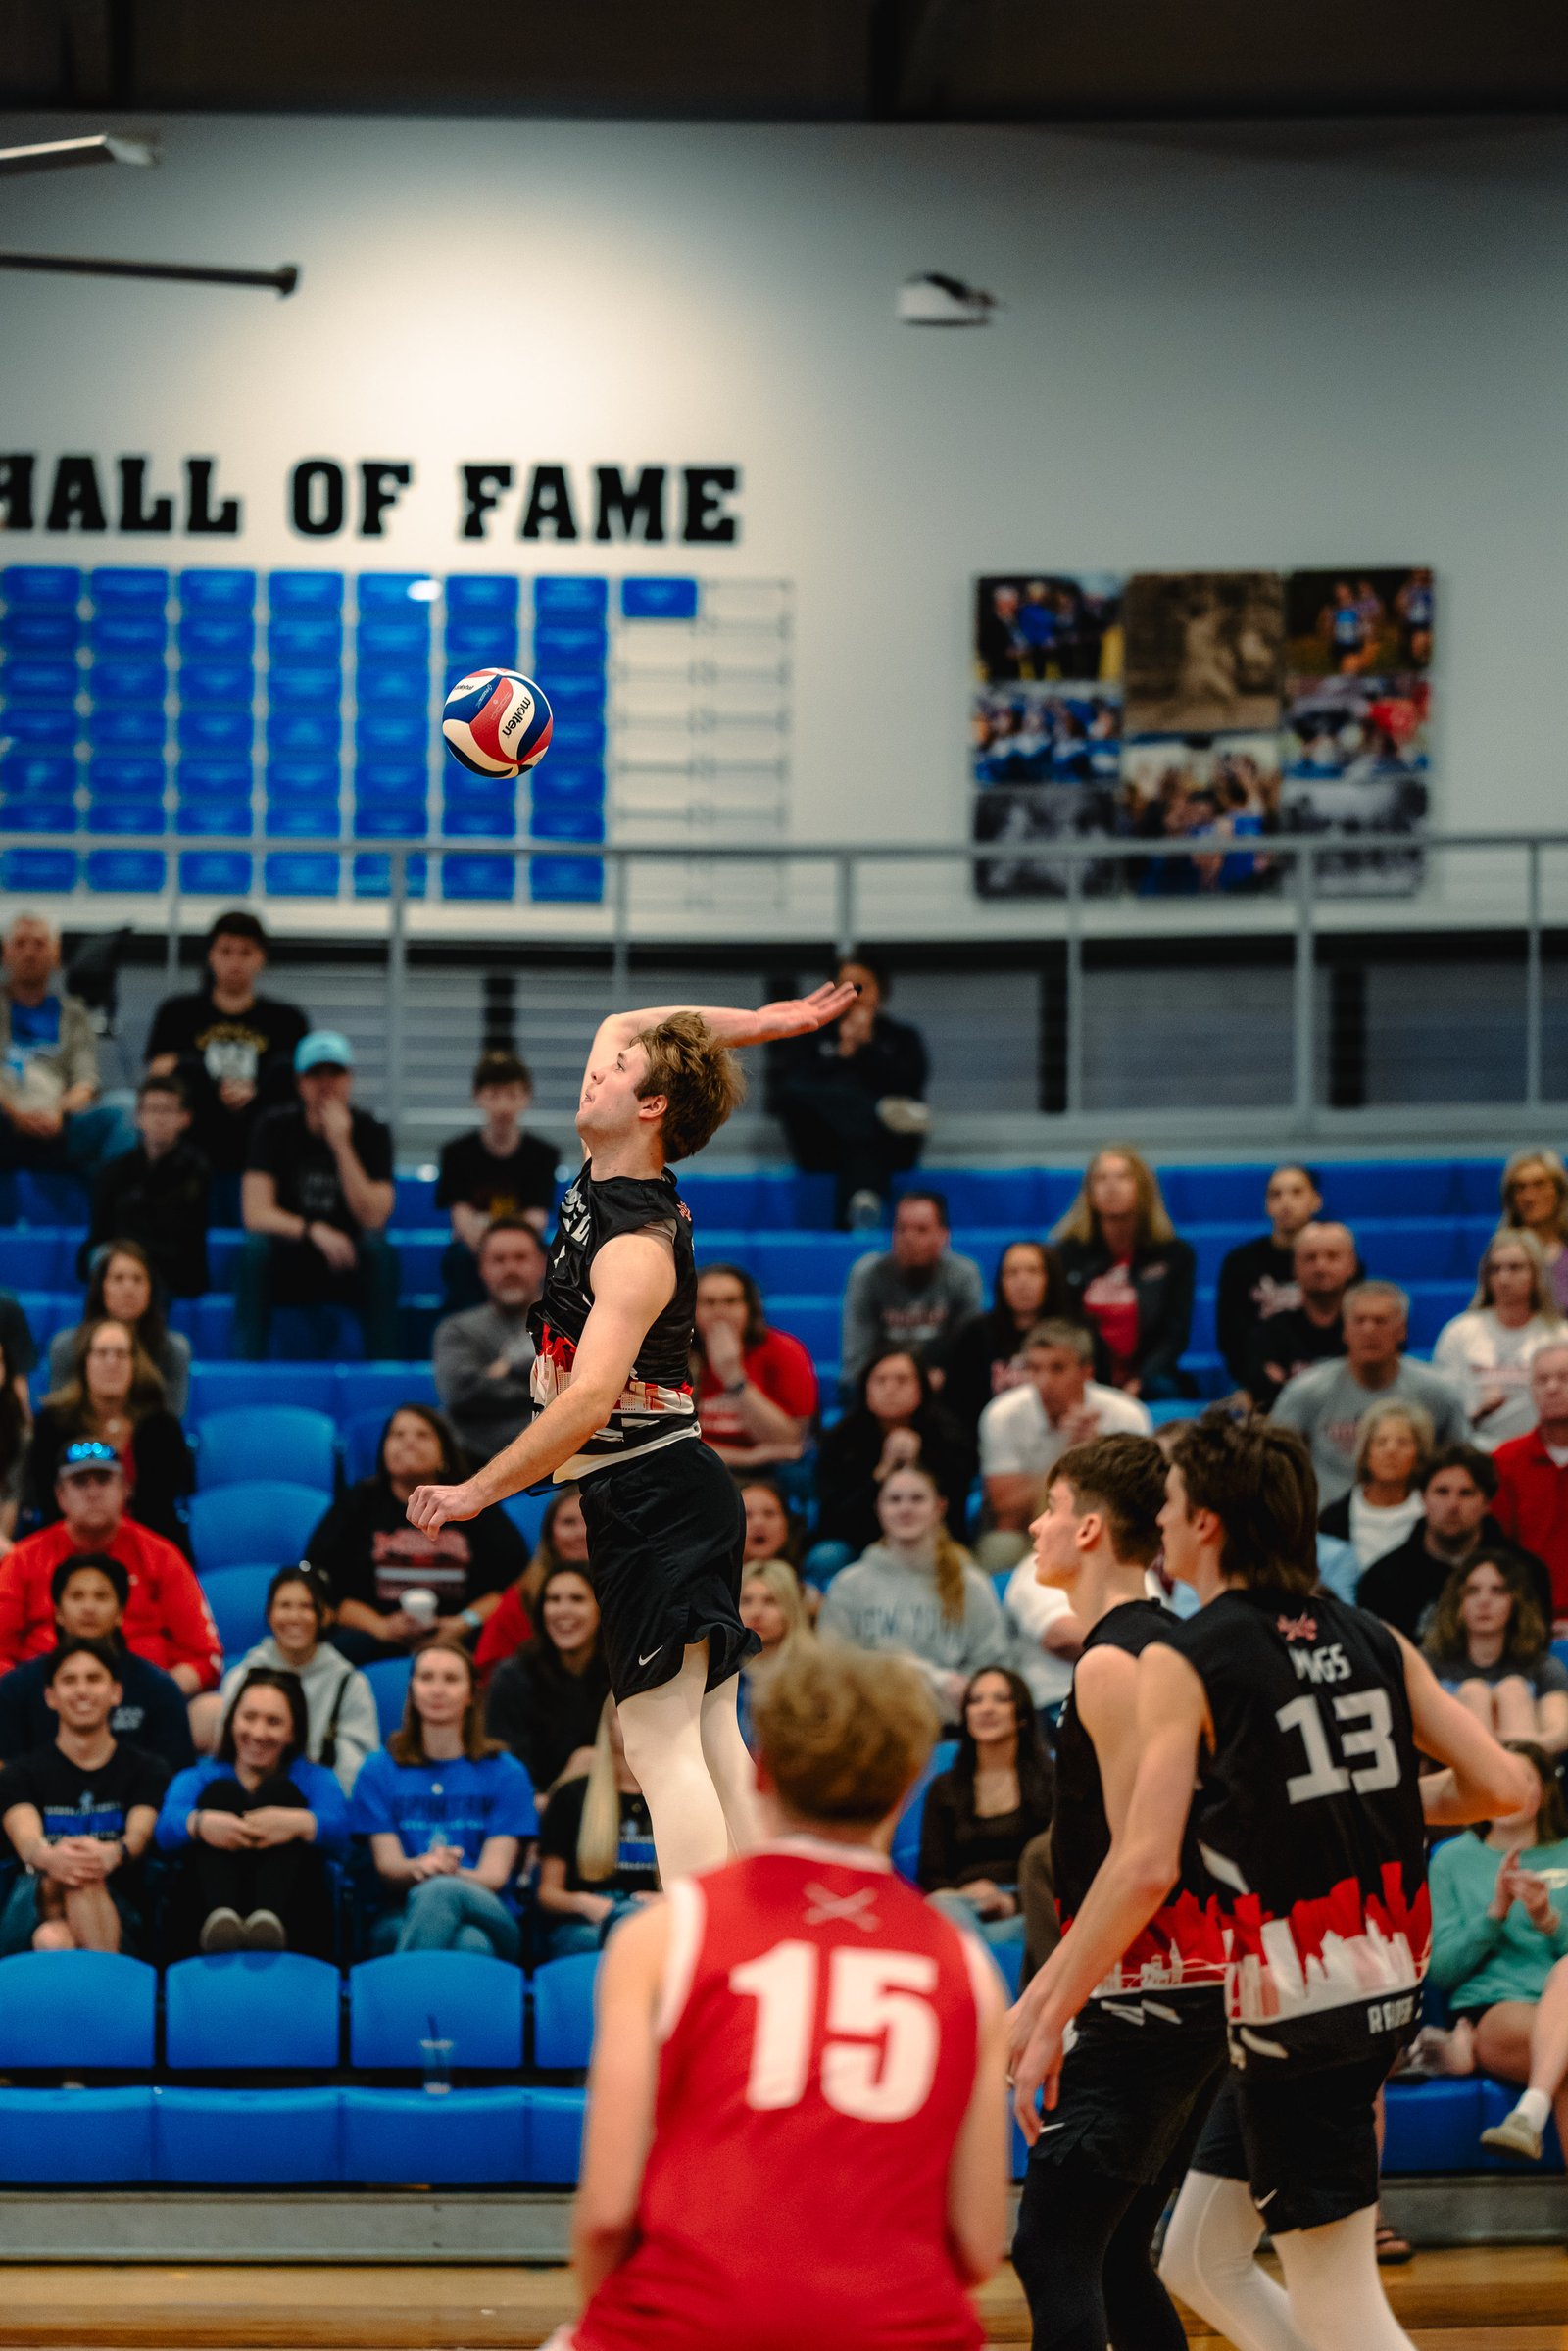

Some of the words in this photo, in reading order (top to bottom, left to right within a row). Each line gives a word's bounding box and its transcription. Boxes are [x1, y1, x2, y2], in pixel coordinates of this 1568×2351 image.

[292, 459, 412, 537] OF
[463, 464, 739, 542] FAME
[502, 696, 531, 737] molten
[1275, 1687, 1402, 1805] 13
[728, 1936, 941, 2124] 15
